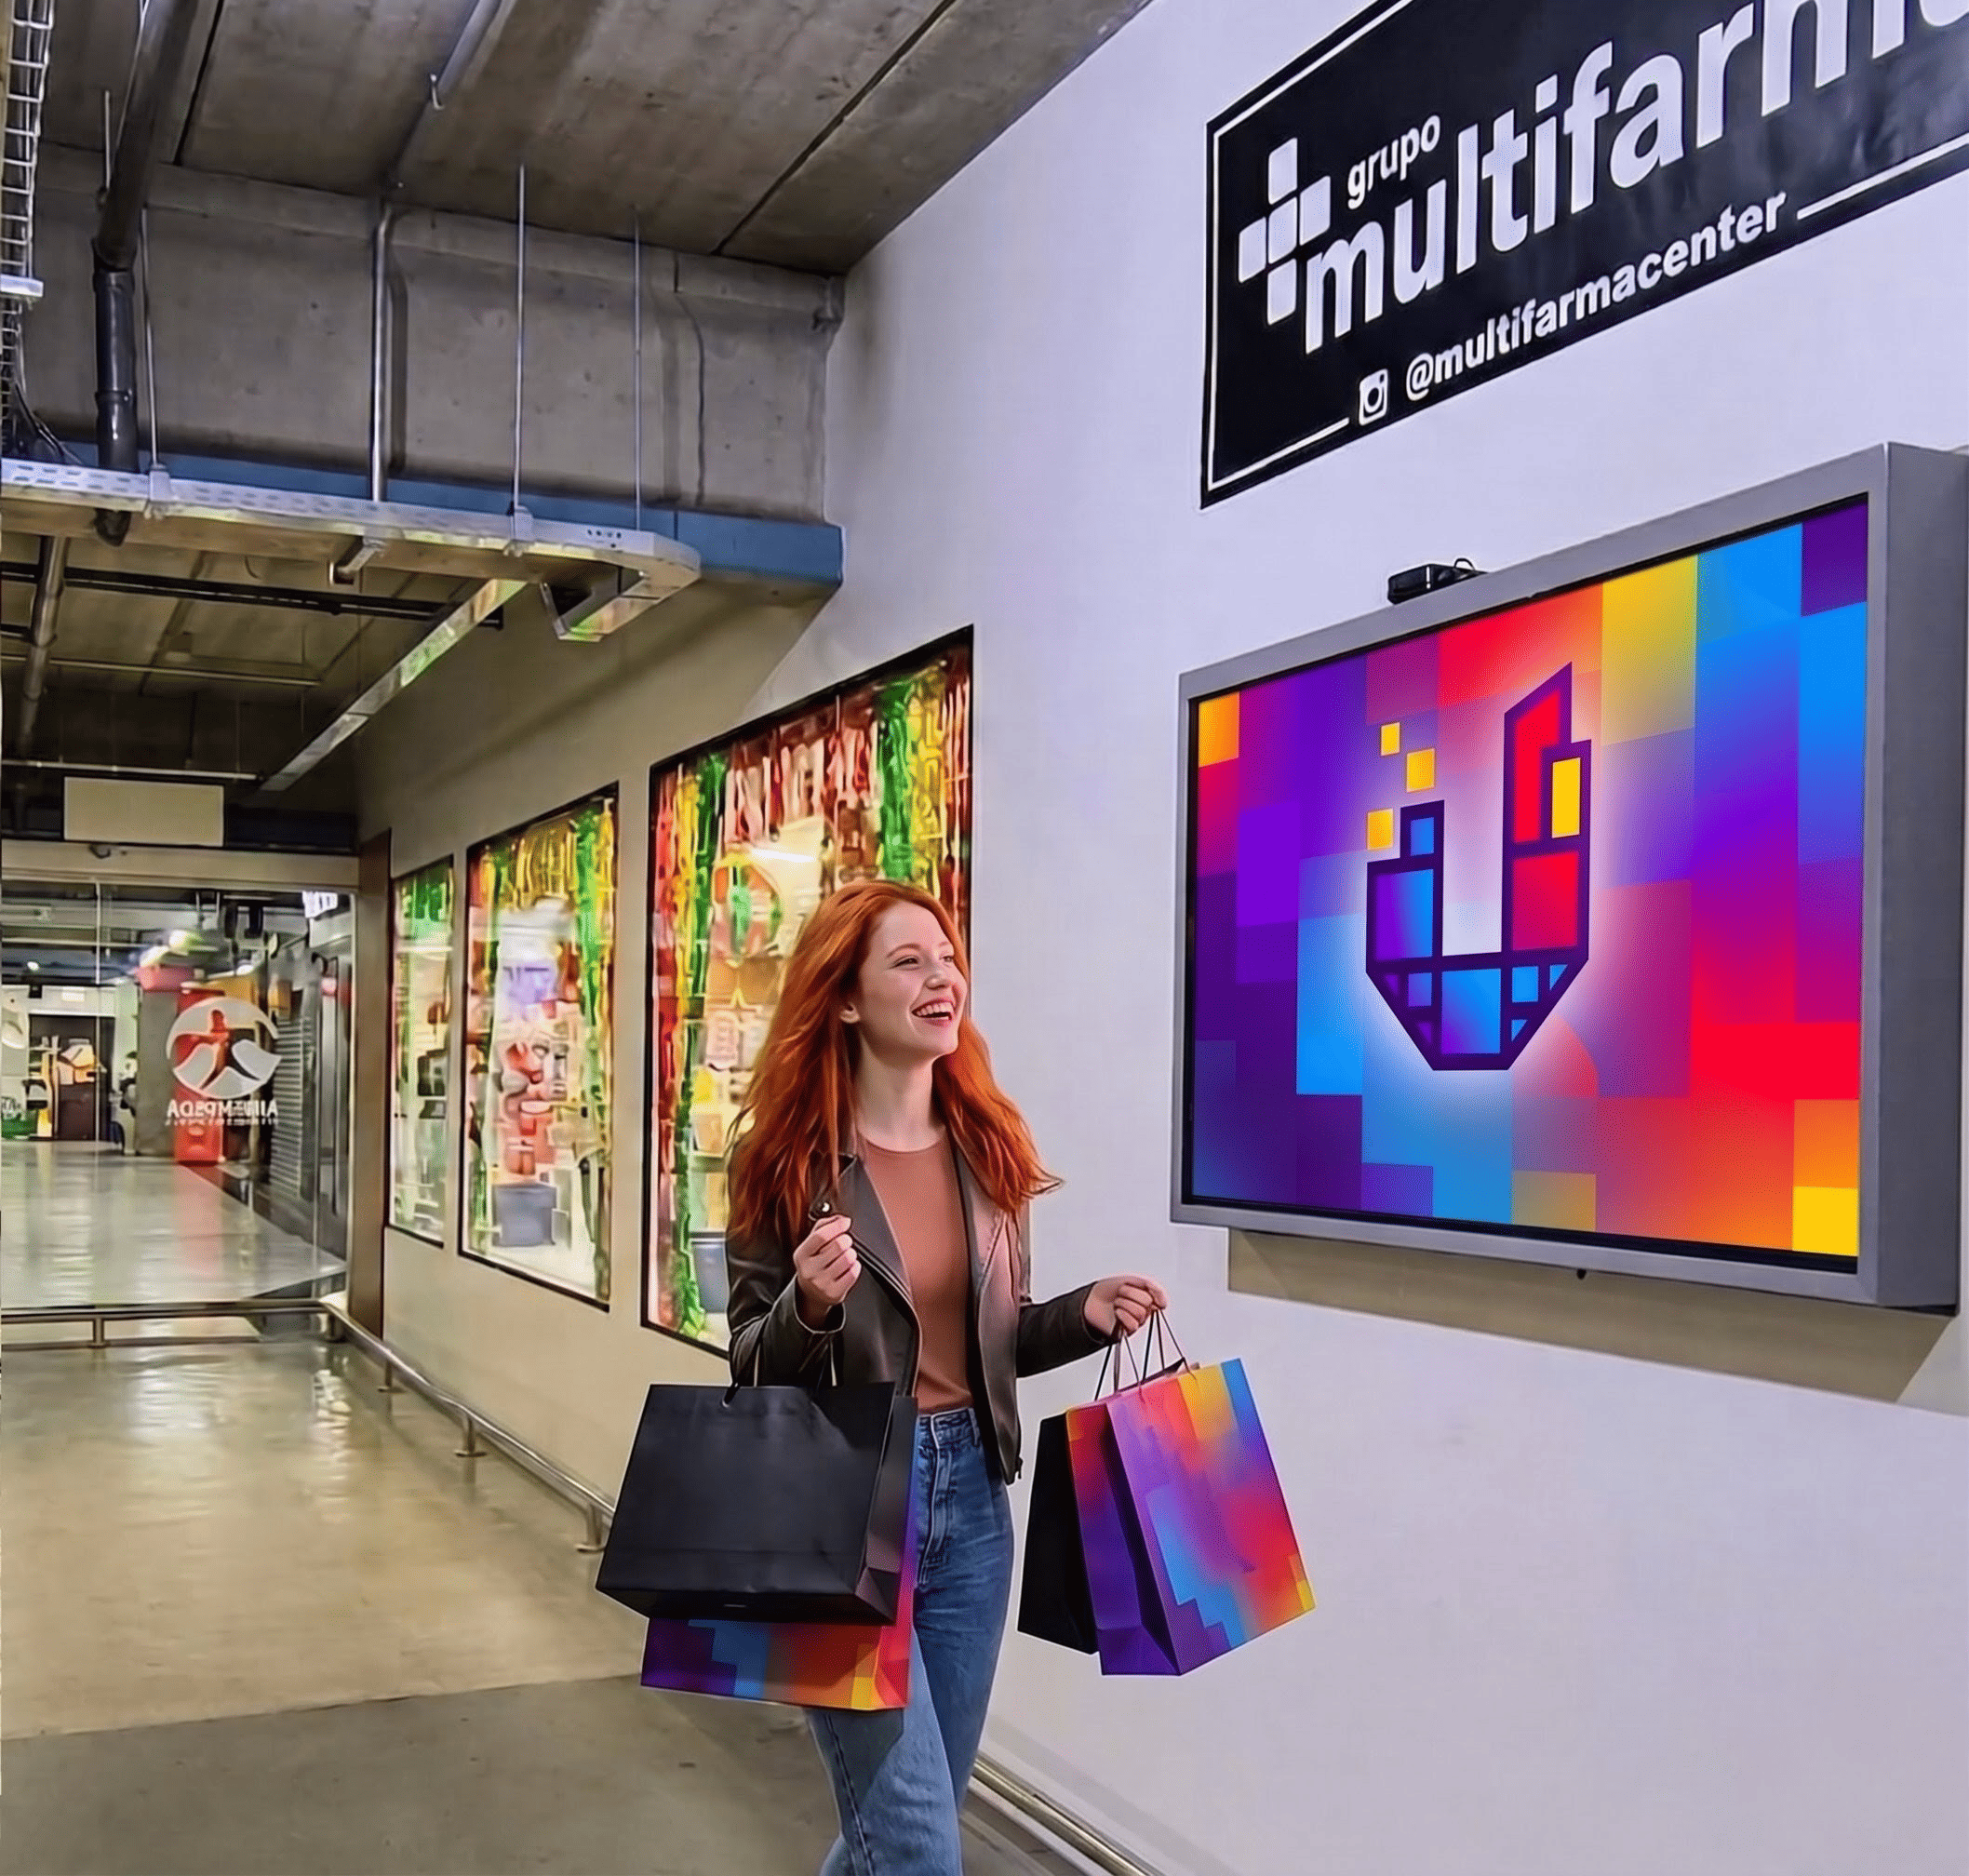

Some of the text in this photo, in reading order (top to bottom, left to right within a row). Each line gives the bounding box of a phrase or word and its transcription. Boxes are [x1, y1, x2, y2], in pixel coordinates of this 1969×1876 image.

[1305, 0, 1969, 355] multifarm
[1347, 114, 1440, 210] grupo
[1405, 191, 1787, 401] @multifarmacenter
